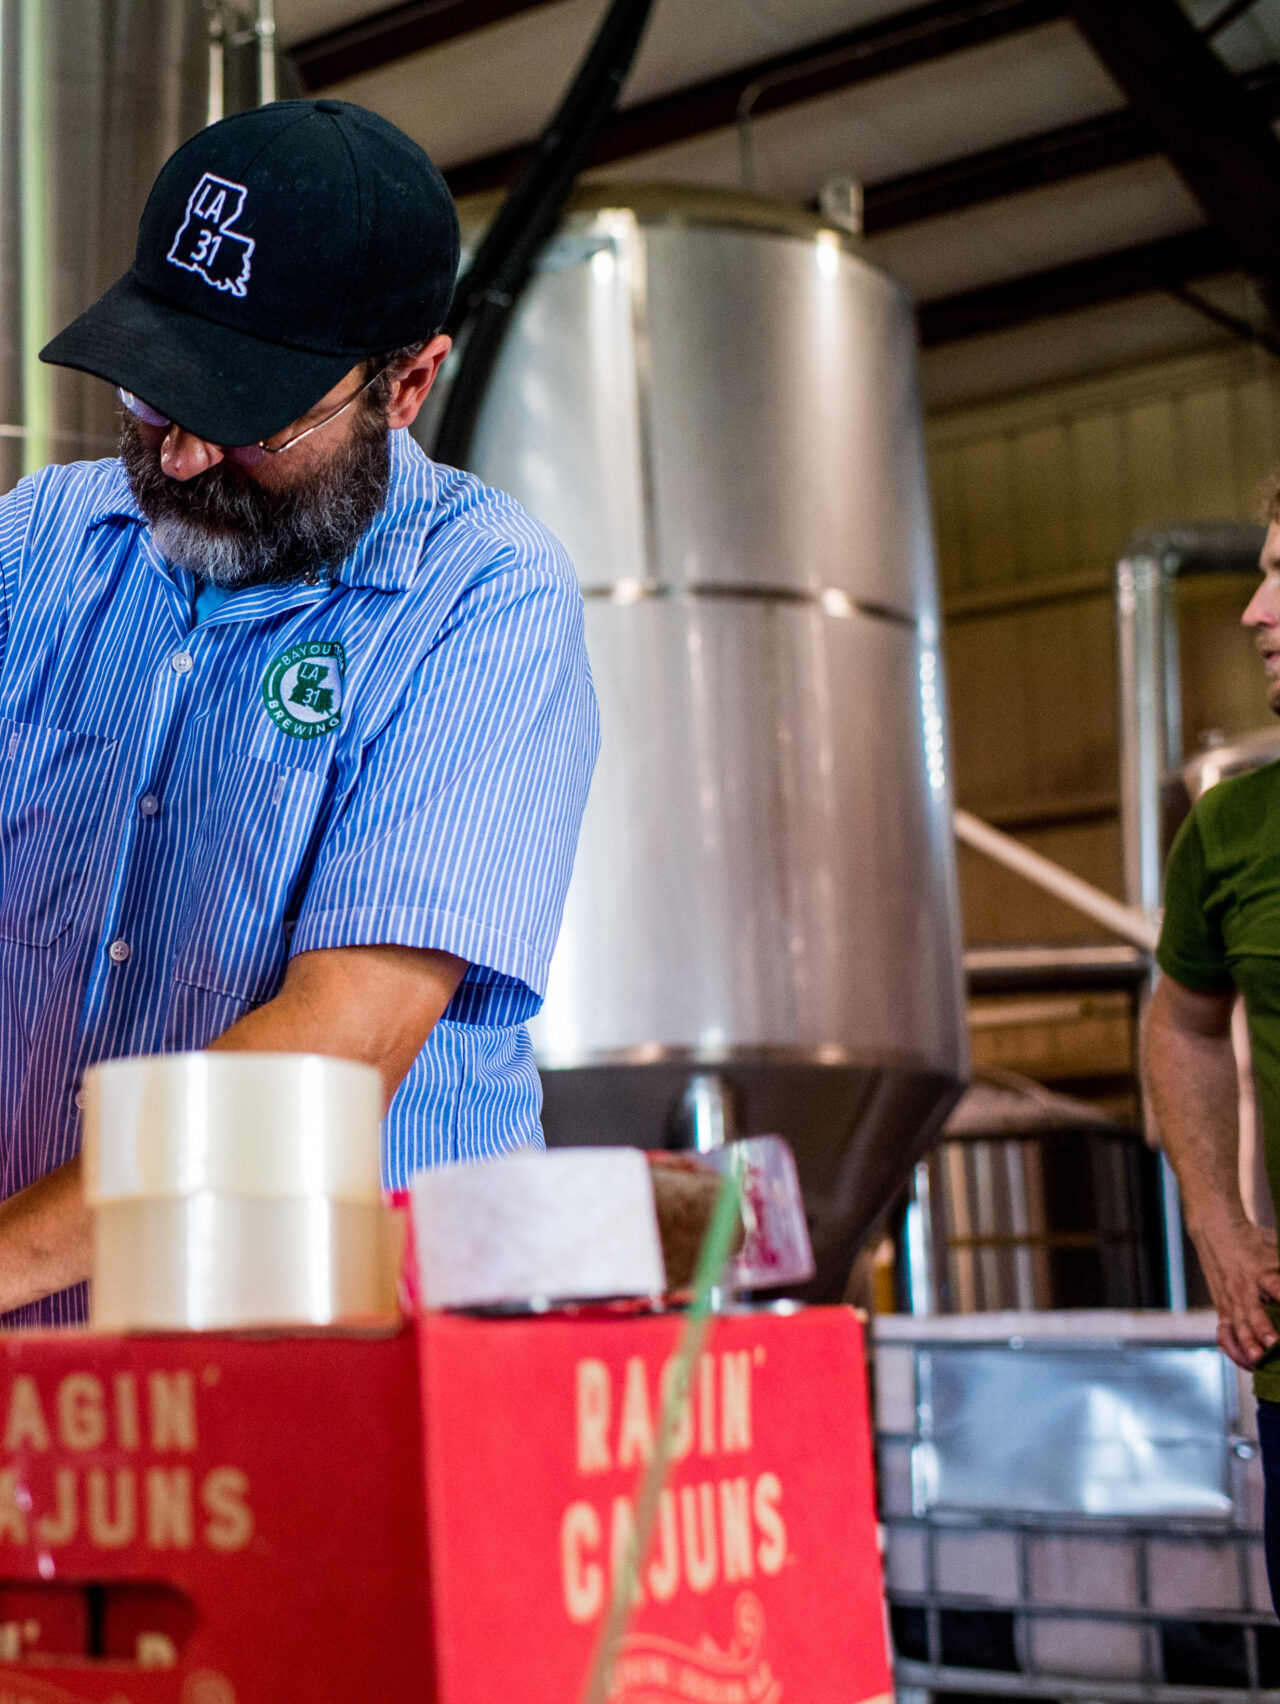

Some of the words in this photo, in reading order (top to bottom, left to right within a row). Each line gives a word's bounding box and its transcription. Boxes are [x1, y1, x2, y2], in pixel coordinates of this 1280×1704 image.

[193, 184, 226, 224] LA
[190, 229, 222, 267] 31
[281, 644, 332, 665] BAYOU
[300, 664, 319, 680] LA
[302, 688, 321, 706] 31
[268, 699, 340, 736] BREWING
[562, 1472, 788, 1624] CAJUNS
